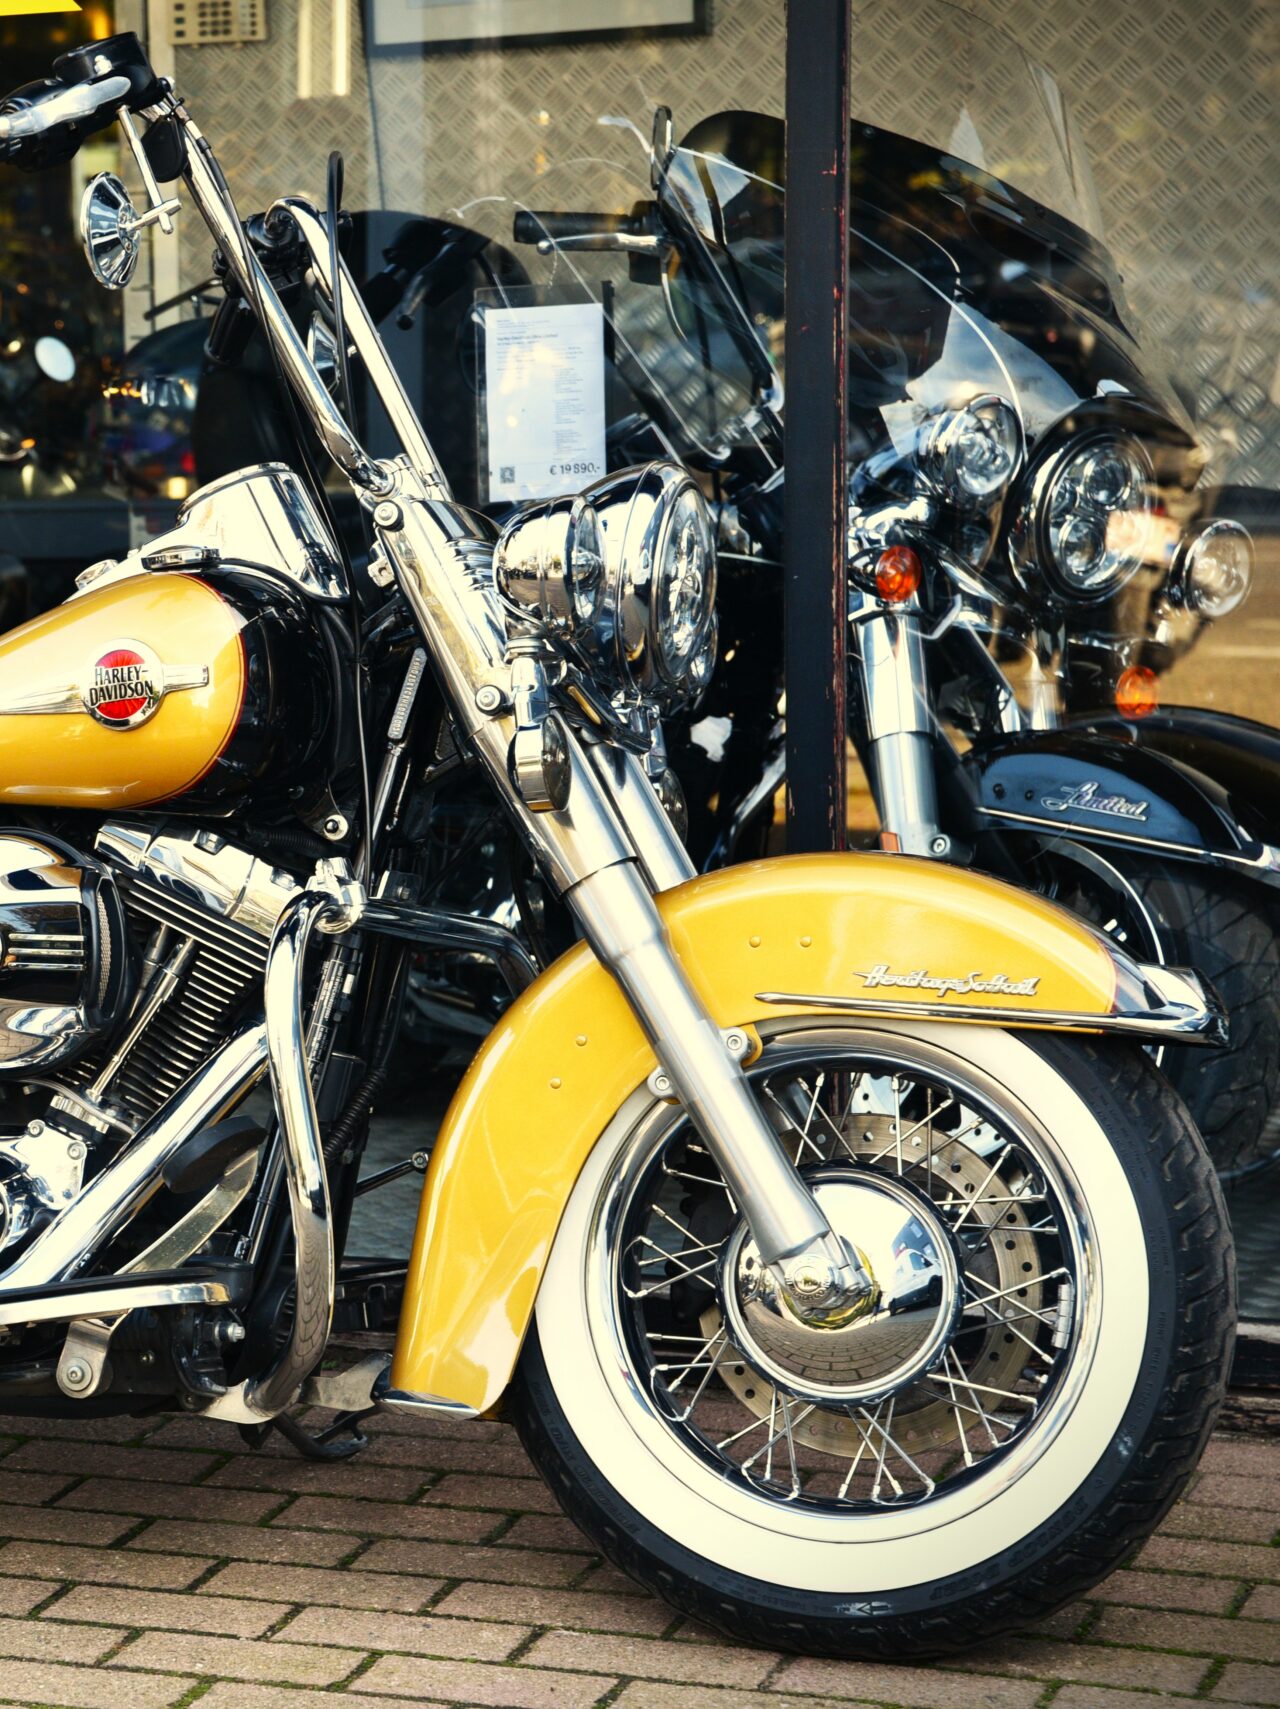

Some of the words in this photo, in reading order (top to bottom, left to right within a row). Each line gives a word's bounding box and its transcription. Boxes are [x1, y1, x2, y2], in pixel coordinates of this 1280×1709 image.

[95, 665, 149, 686] HARLEY-
[88, 680, 154, 707] DAVIDSON
[1040, 781, 1148, 821] Limited
[853, 965, 966, 998] Heritage
[960, 971, 1041, 996] Softail
